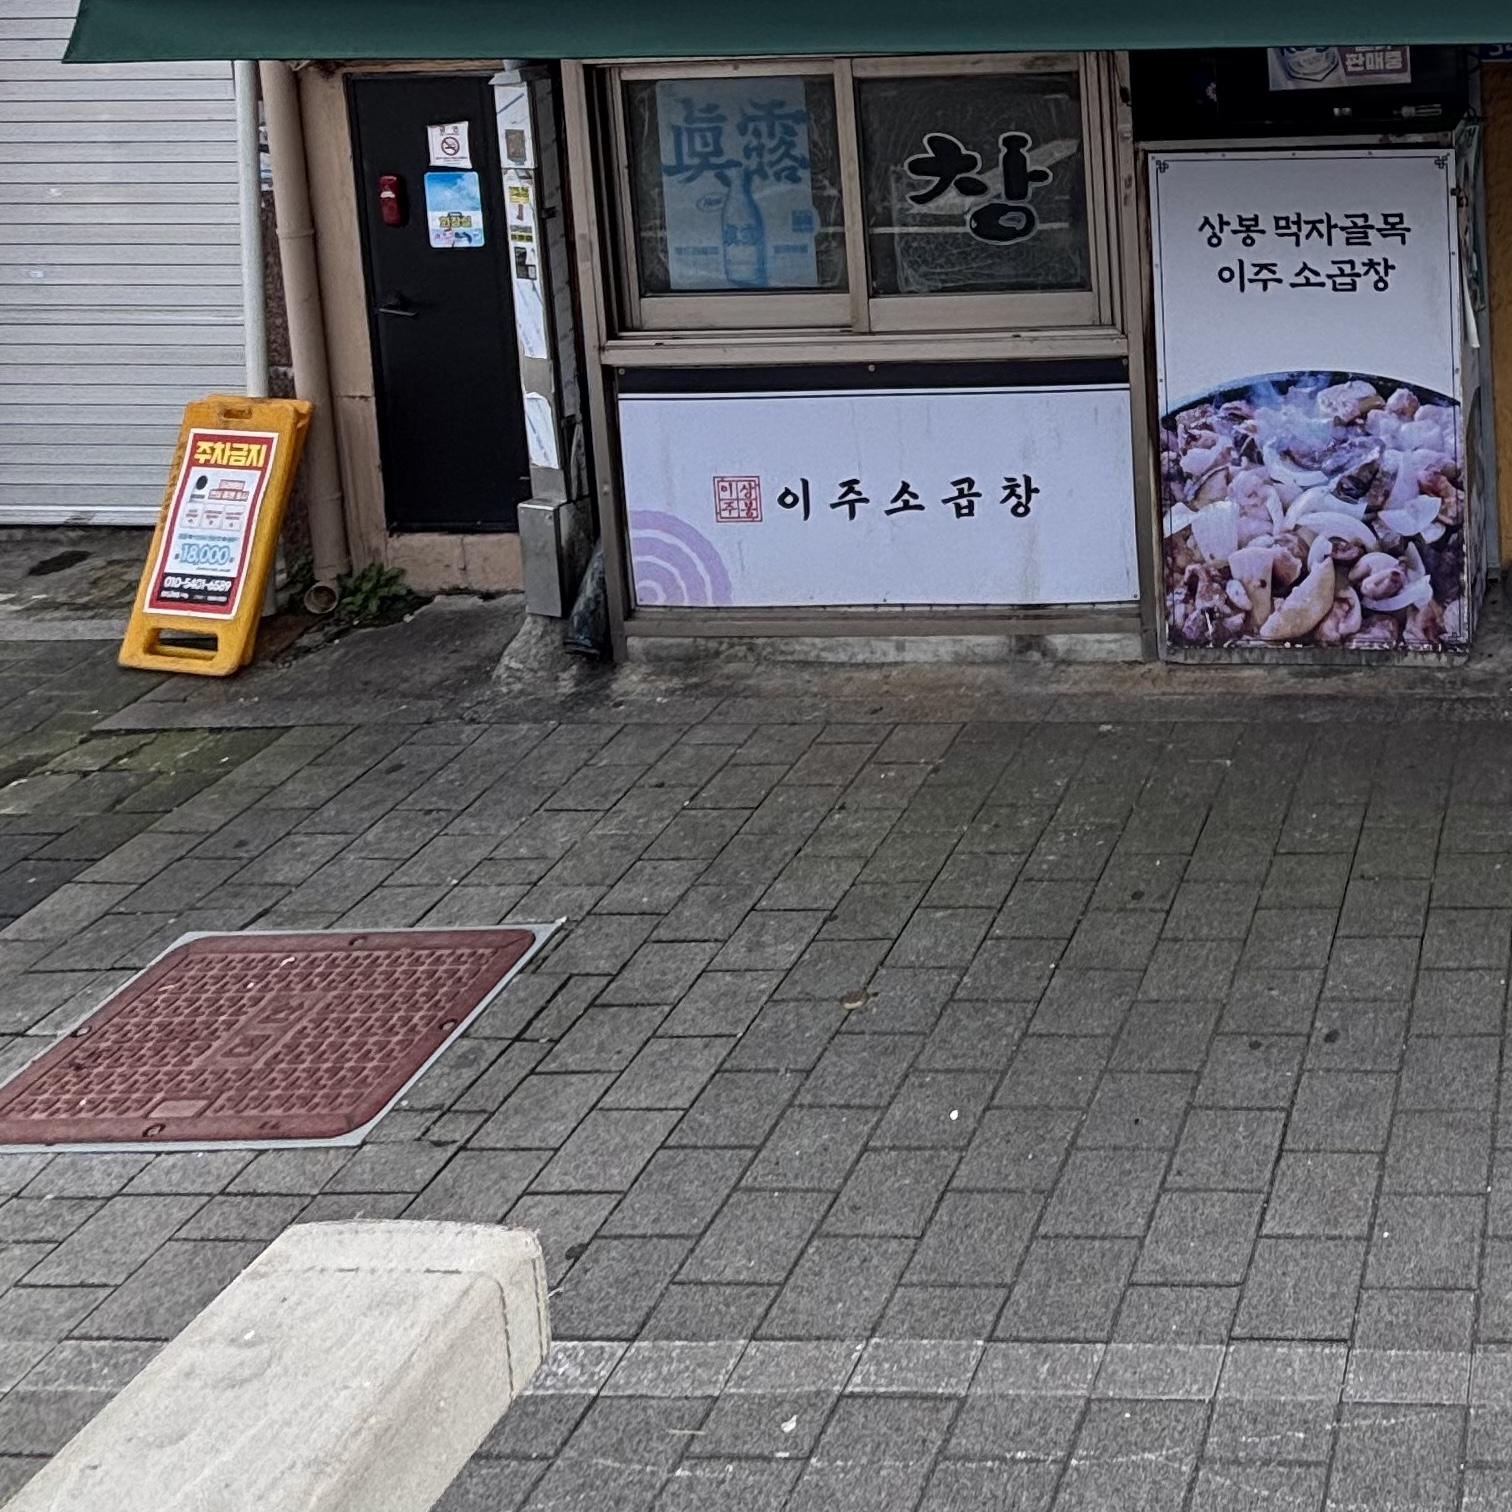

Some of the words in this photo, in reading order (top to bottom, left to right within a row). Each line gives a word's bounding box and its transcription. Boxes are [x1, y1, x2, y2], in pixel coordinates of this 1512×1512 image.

[1198, 212, 1266, 248] 상봉
[1273, 212, 1411, 248] 먹자골목
[1218, 259, 1283, 293] 이주
[1289, 257, 1396, 293] 소곱창
[194, 441, 267, 468] 주차금지
[776, 474, 1041, 521] 이주소곱창
